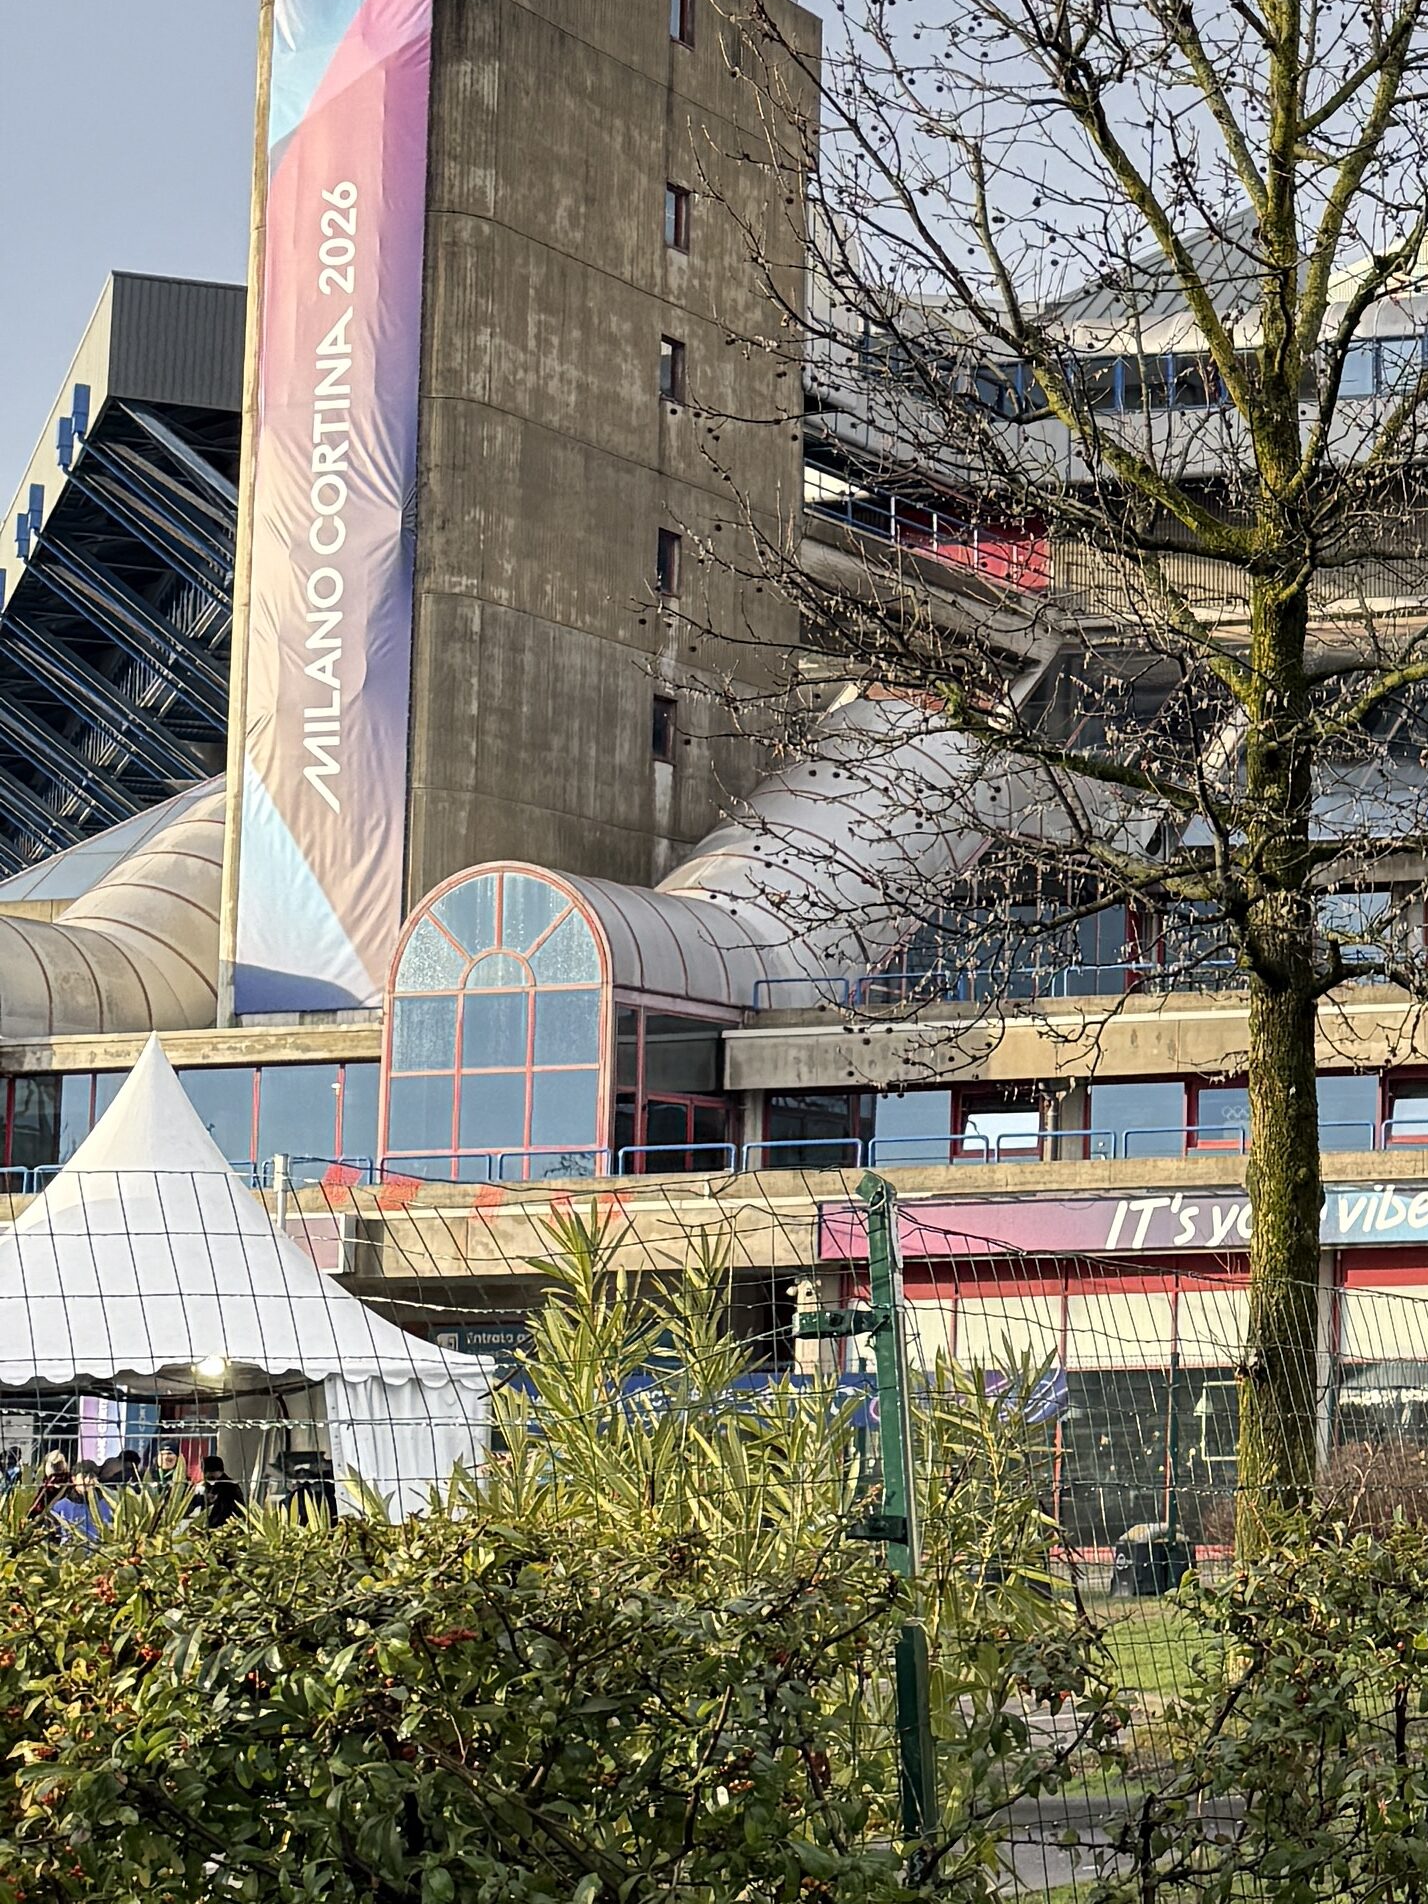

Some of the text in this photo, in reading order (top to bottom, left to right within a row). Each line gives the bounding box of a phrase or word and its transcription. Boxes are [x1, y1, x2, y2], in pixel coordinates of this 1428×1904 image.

[302, 179, 358, 815] MILANO CORTINA 2026
[1104, 1192, 1200, 1250] IT's
